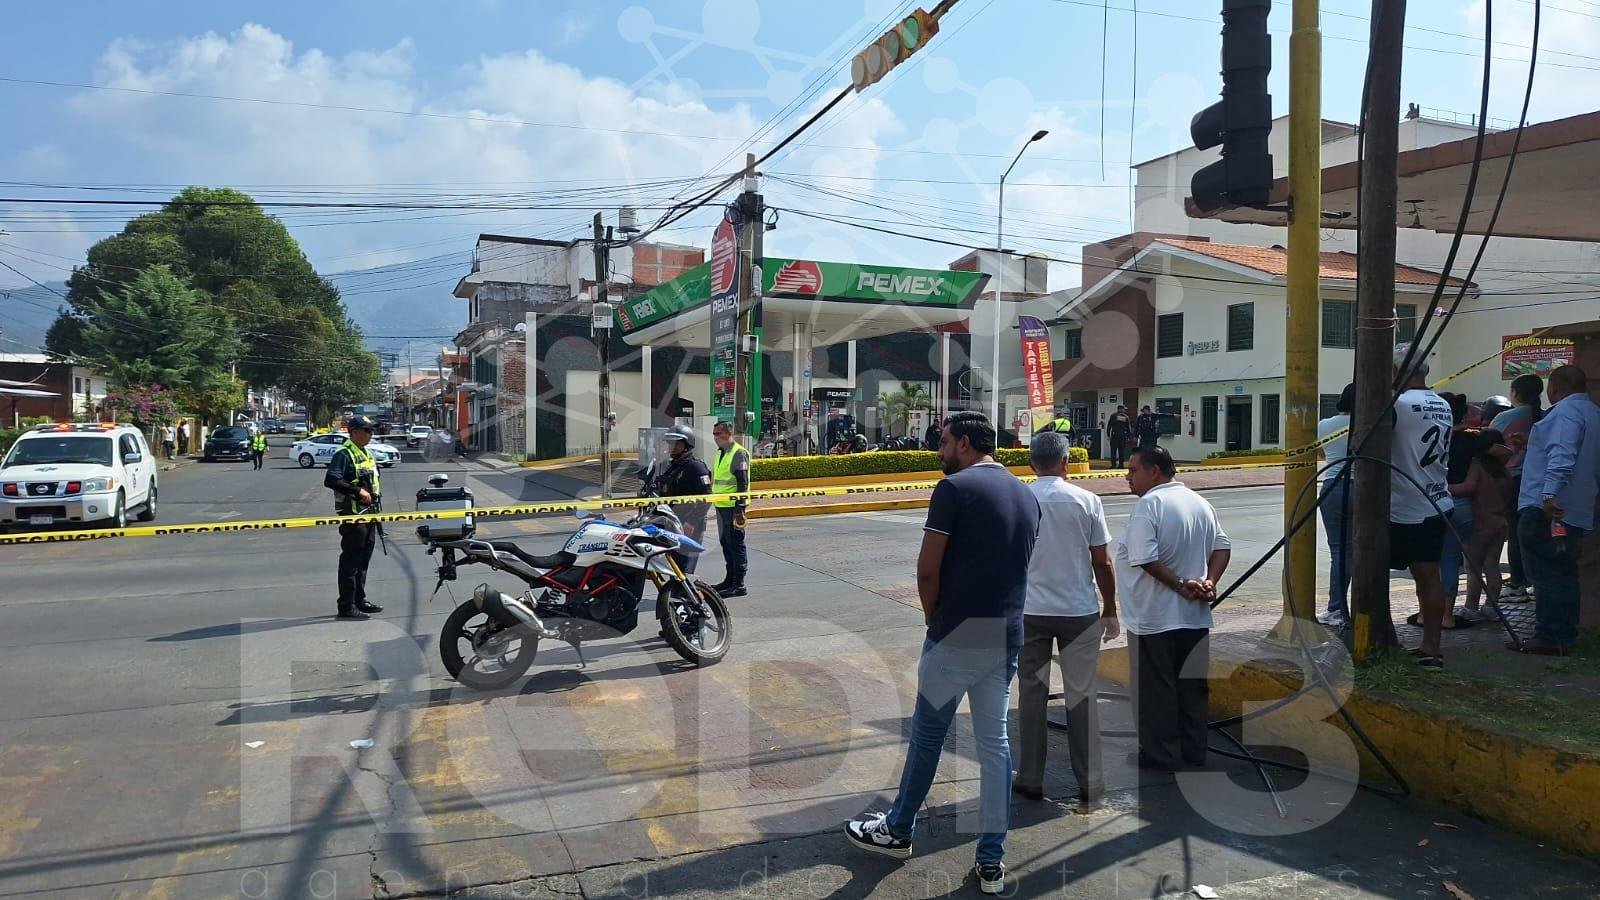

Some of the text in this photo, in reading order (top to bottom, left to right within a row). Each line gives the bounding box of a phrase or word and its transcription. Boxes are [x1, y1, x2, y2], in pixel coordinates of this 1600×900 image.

[857, 272, 944, 295] PEMEX
[632, 299, 657, 319] PEMEX
[713, 293, 738, 315] PEMEX
[1026, 342, 1041, 405] TARJETAS
